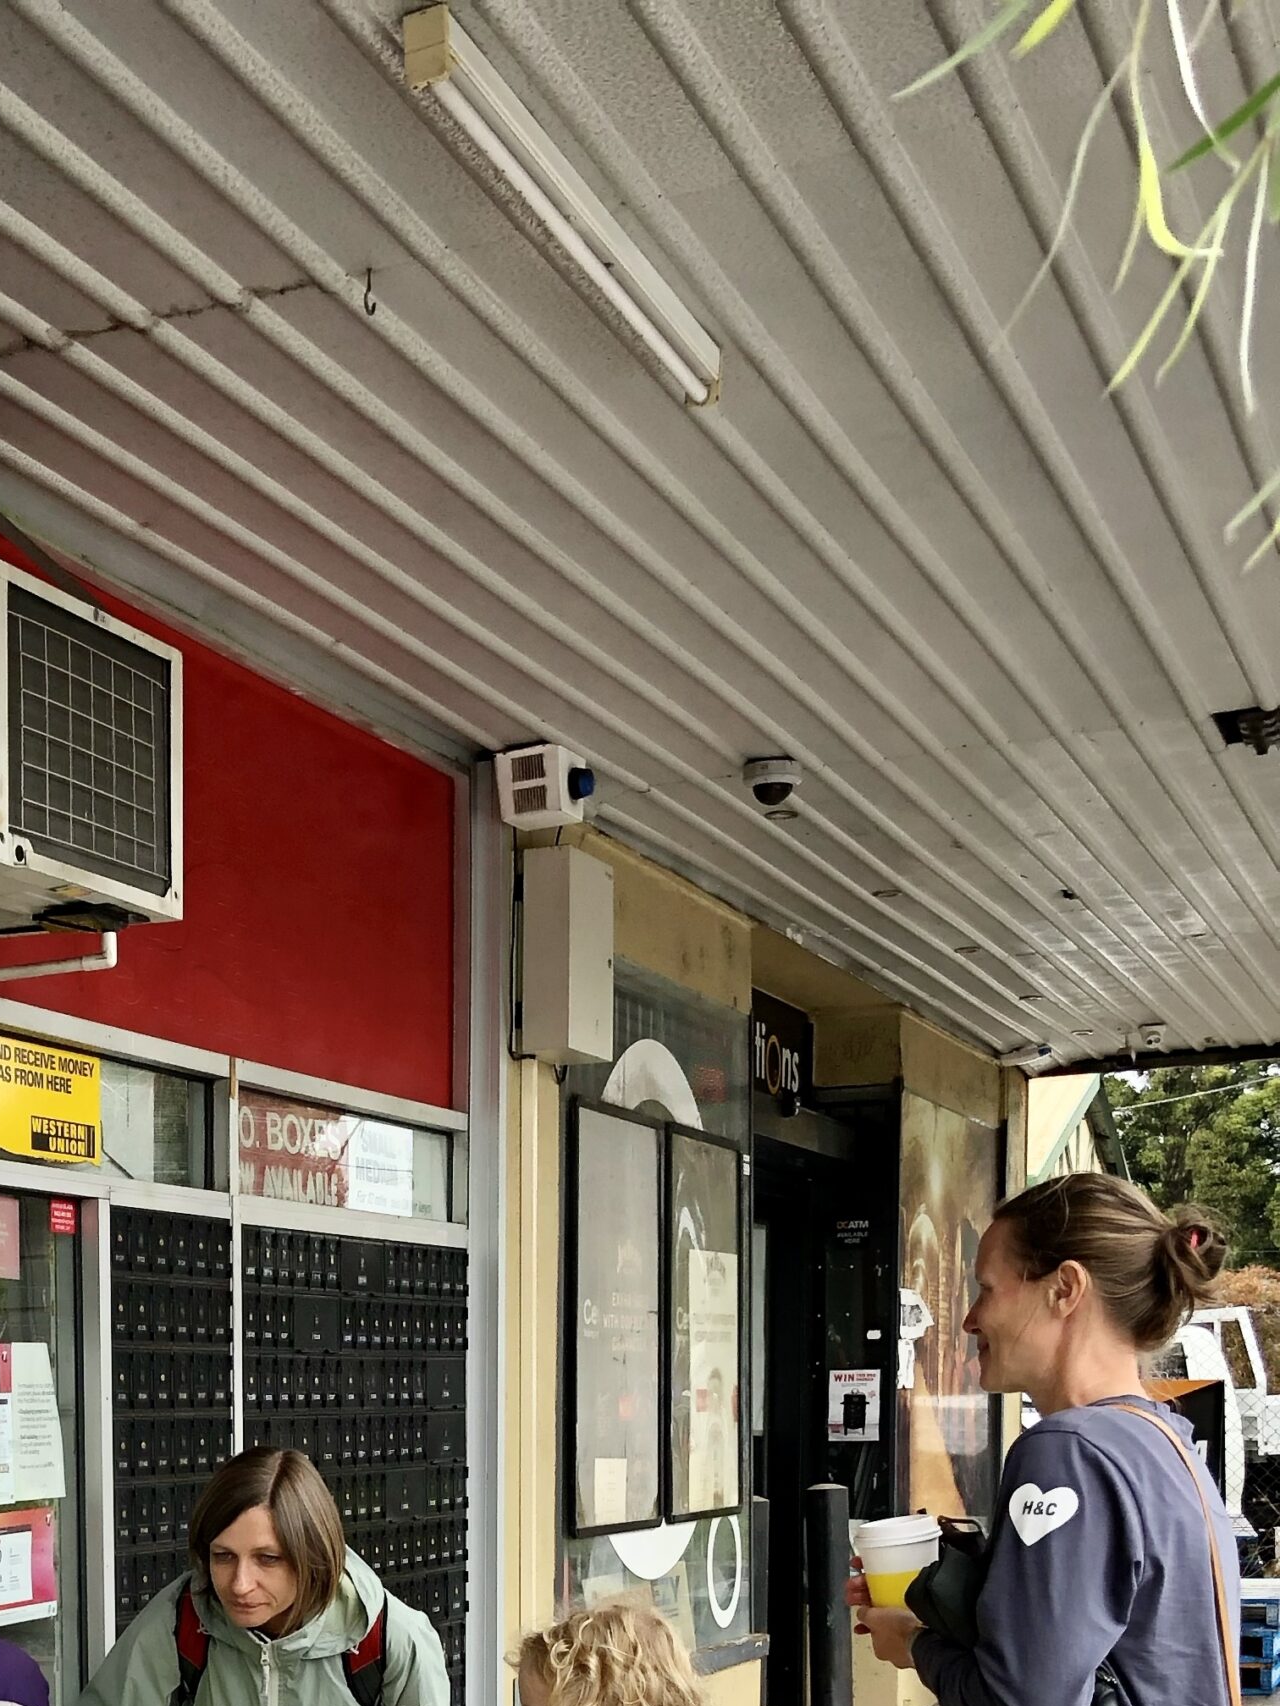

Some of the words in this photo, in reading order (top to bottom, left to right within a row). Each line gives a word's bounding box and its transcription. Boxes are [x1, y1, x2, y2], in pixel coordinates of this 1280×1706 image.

[14, 1047, 55, 1070] RECEIVE
[58, 1056, 95, 1078] MONEY
[14, 1068, 44, 1089] FROM
[46, 1075, 72, 1094] HERE
[31, 1117, 86, 1140] WESTERN
[266, 1111, 342, 1161] BOXES
[48, 1136, 86, 1156] UNION
[834, 1373, 855, 1382] WIN
[1022, 1500, 1058, 1516] H&C
